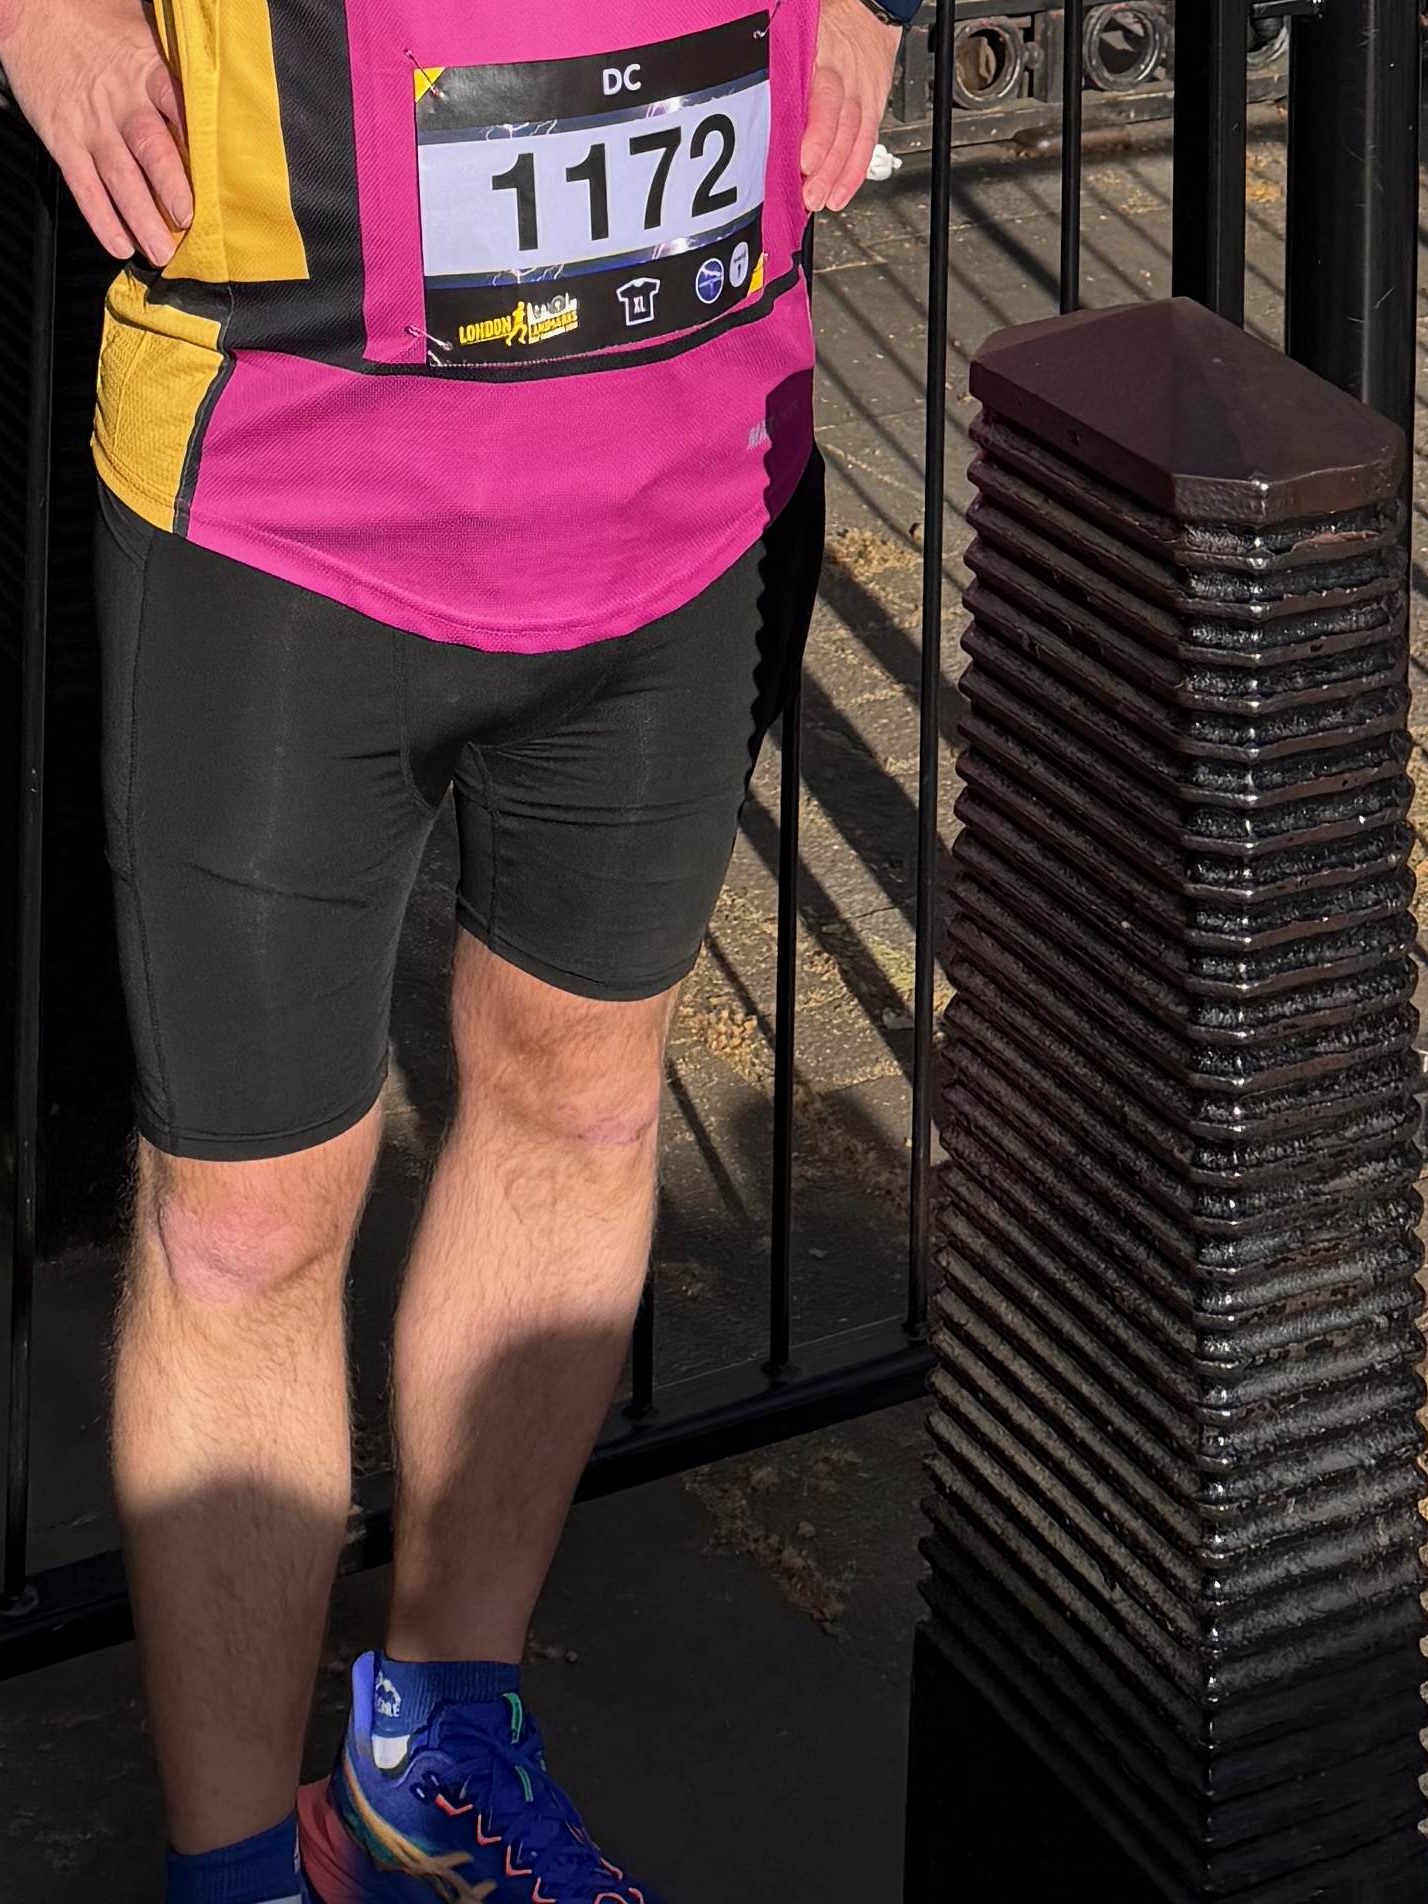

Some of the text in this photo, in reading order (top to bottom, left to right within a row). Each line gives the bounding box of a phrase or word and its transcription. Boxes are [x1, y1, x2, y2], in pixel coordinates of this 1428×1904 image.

[603, 63, 642, 96] DC
[491, 113, 737, 252] 1172
[633, 295, 647, 315] XL
[459, 315, 512, 345] LONDON
